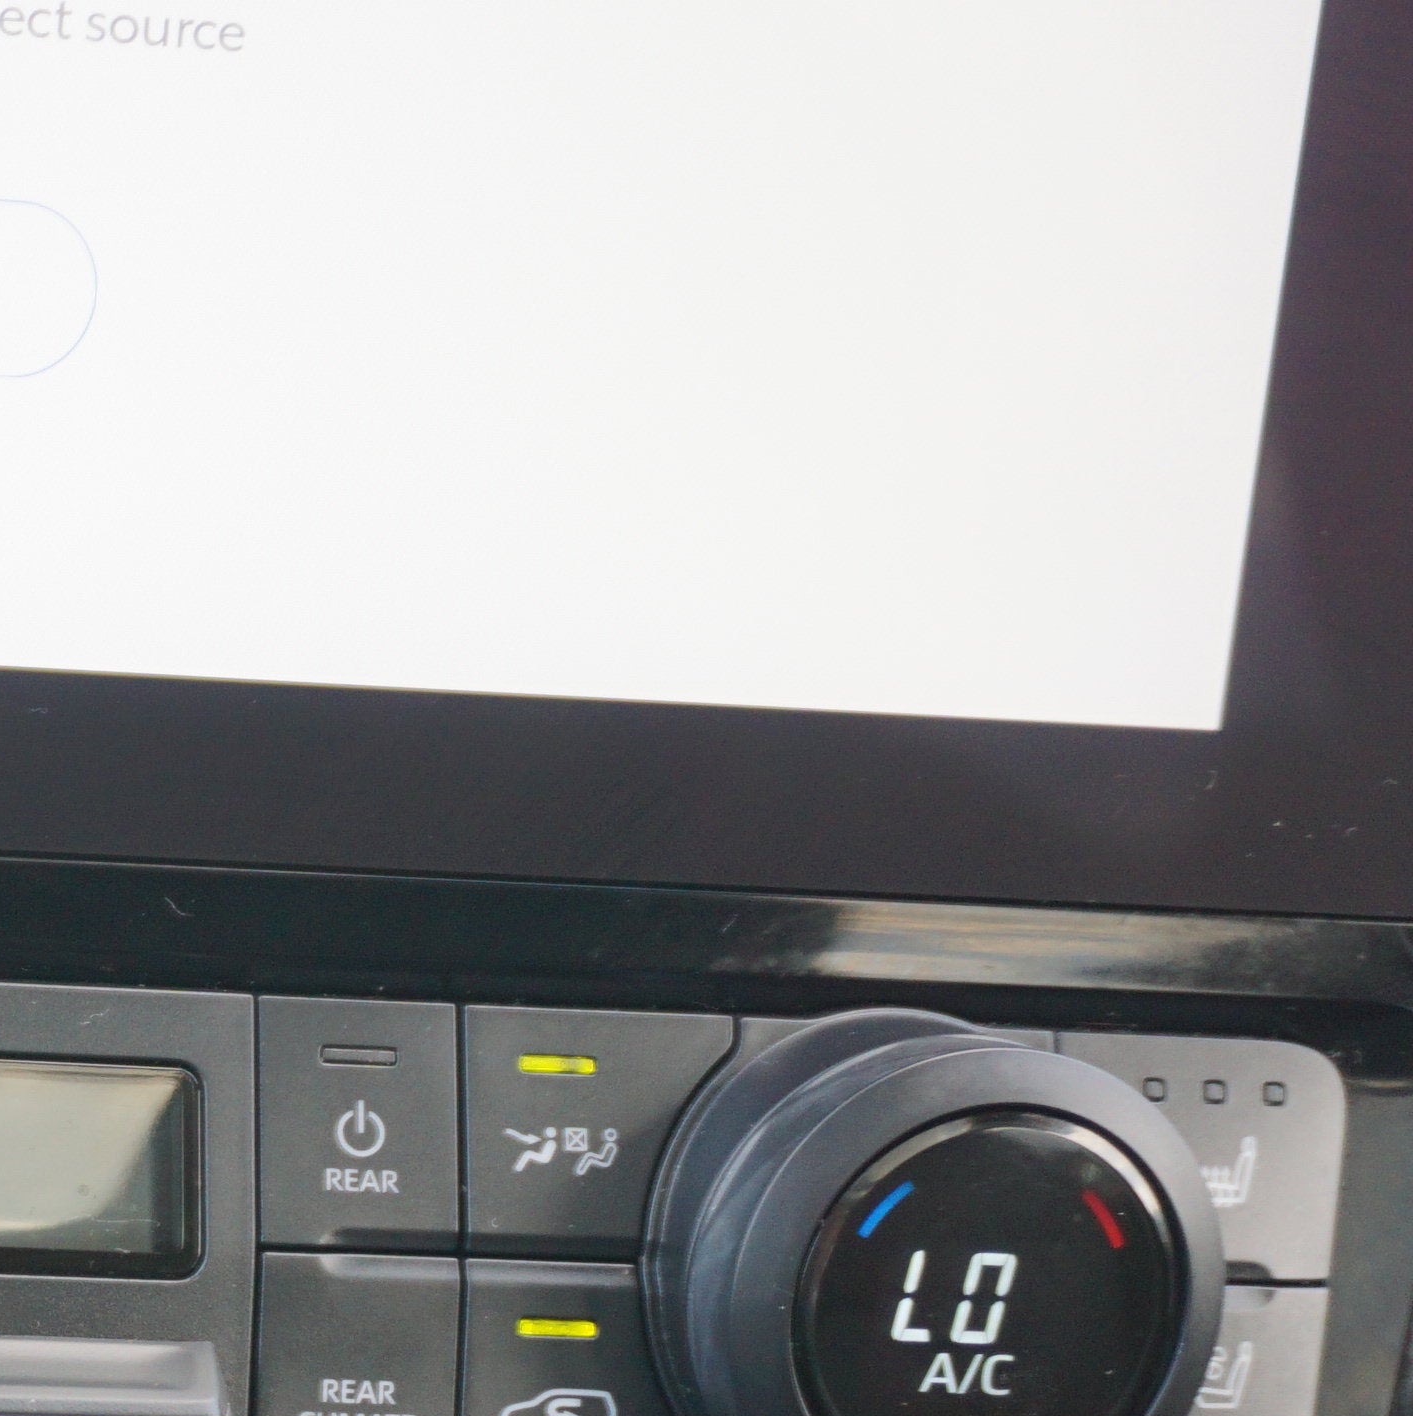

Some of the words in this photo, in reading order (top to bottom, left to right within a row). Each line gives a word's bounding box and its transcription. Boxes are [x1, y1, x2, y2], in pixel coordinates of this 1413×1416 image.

[86, 13, 246, 52] source
[325, 1167, 399, 1193] REAR
[890, 1249, 1018, 1345] LO
[322, 1378, 395, 1405] REAR
[919, 1352, 1015, 1396] A/C
